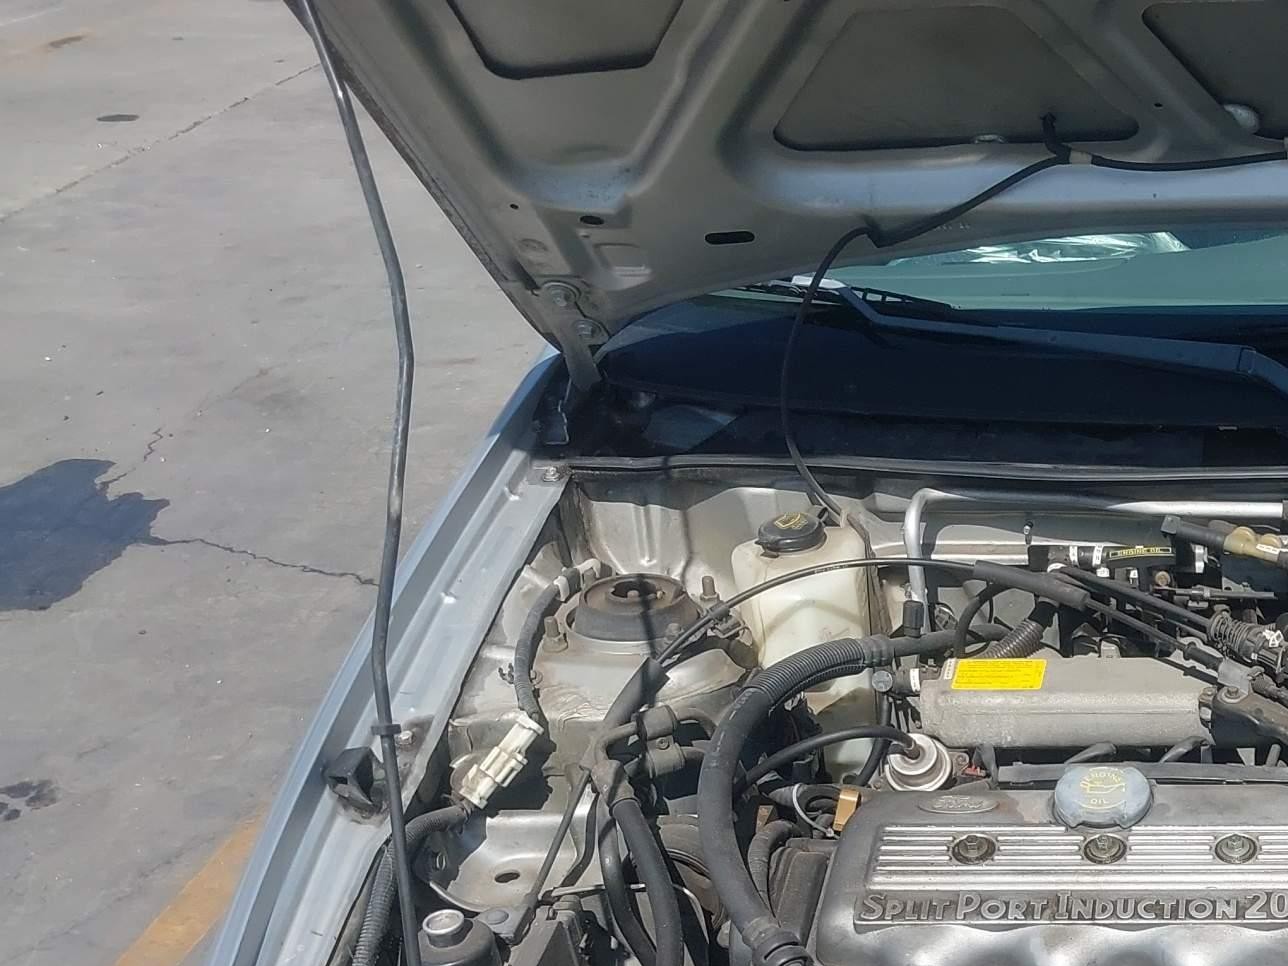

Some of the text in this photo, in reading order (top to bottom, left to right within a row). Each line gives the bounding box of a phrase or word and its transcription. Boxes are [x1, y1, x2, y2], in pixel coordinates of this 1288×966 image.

[859, 894, 953, 921] SPLIT
[956, 891, 1049, 921] PORT
[1055, 891, 1239, 921] INDUCTION
